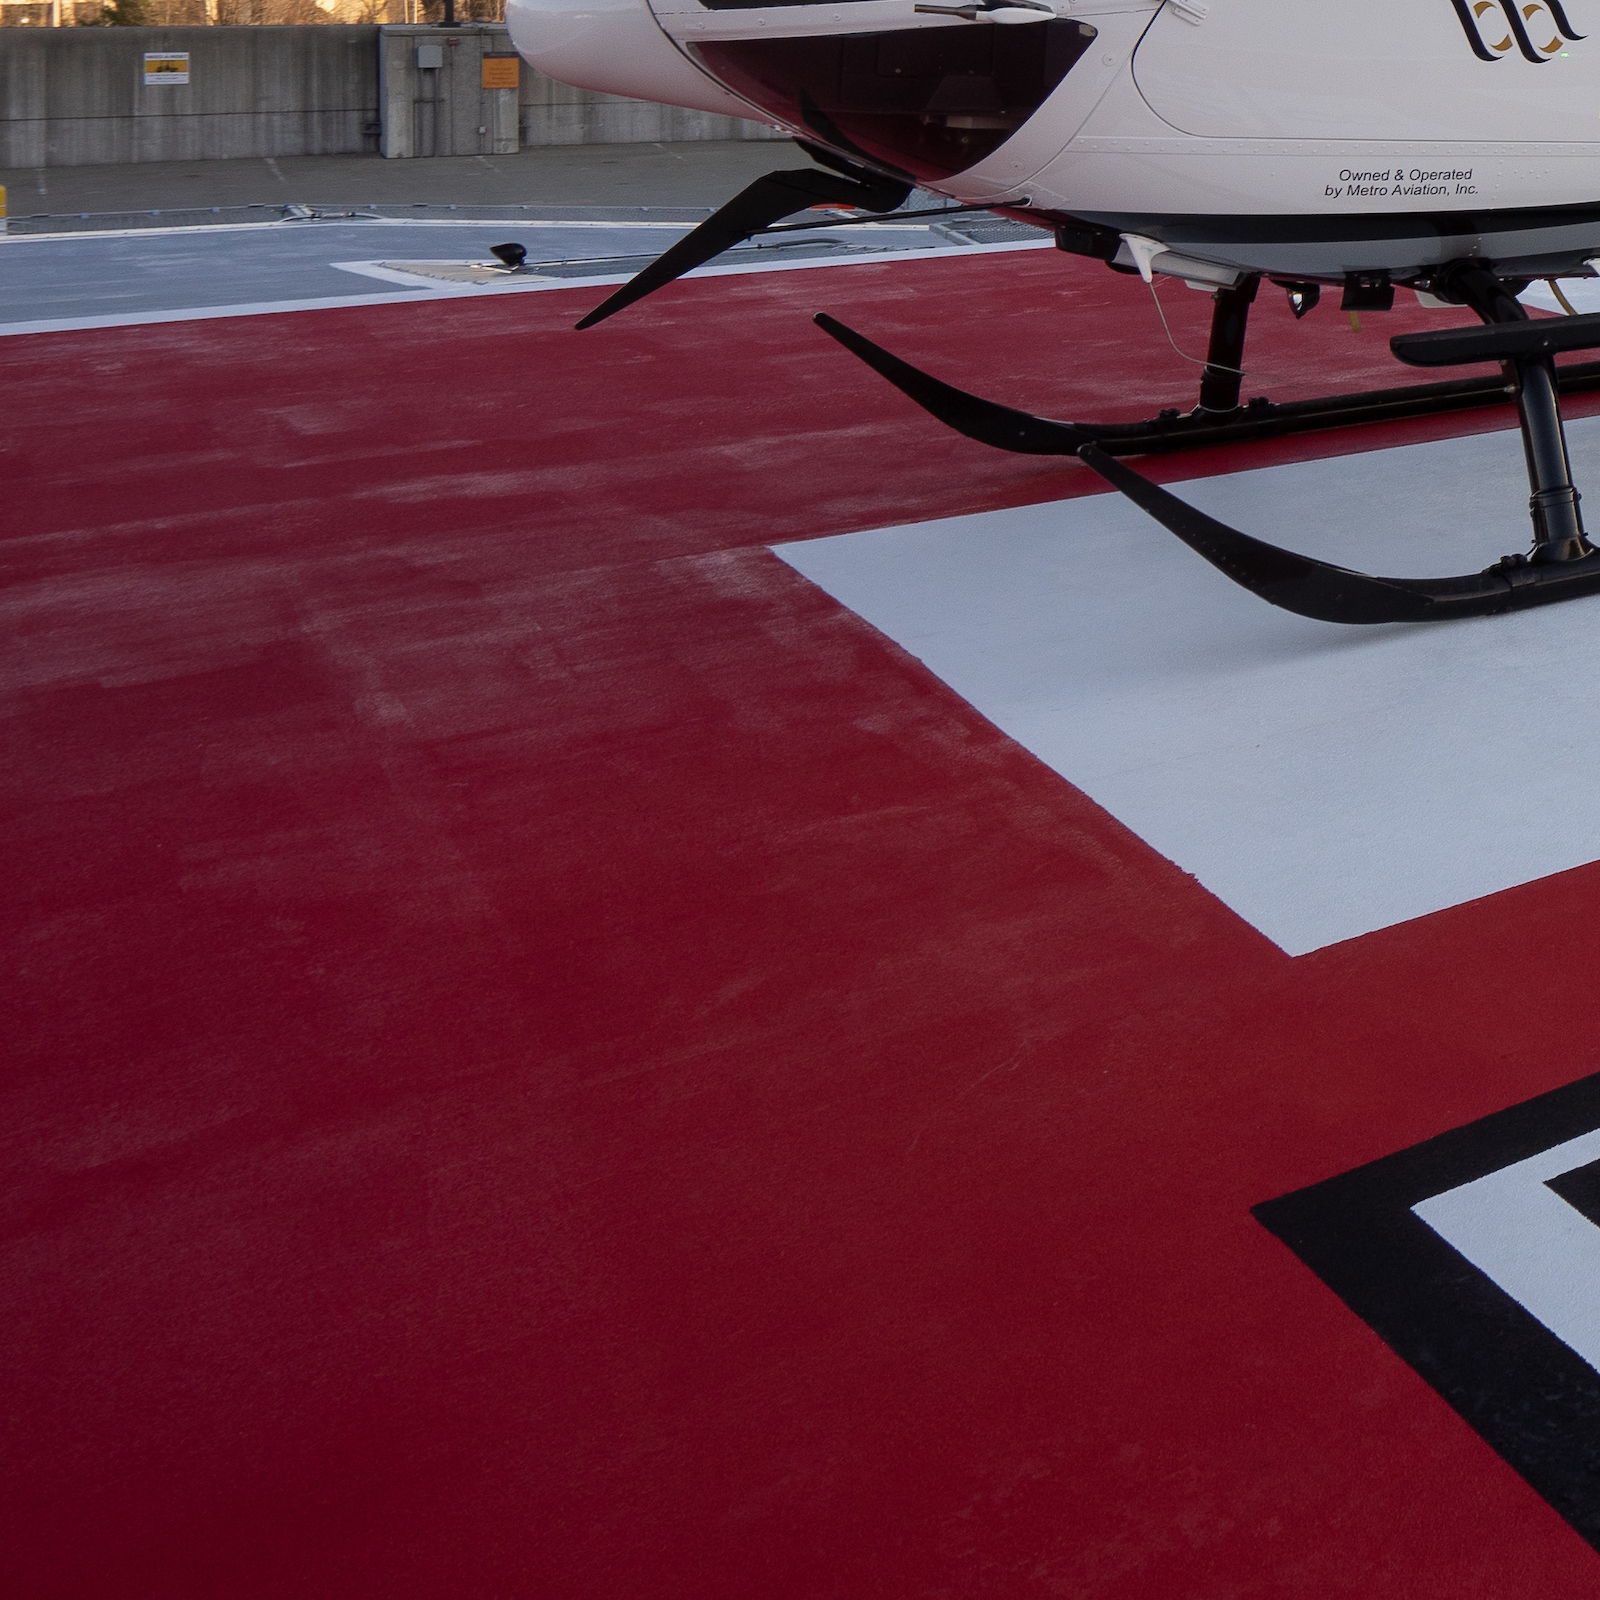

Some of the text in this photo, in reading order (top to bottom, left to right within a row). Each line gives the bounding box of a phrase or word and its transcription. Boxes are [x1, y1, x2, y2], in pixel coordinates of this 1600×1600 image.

[1339, 168, 1473, 183] Owned & Operated
[1324, 183, 1478, 198] by Metro Aviation, Inc.
